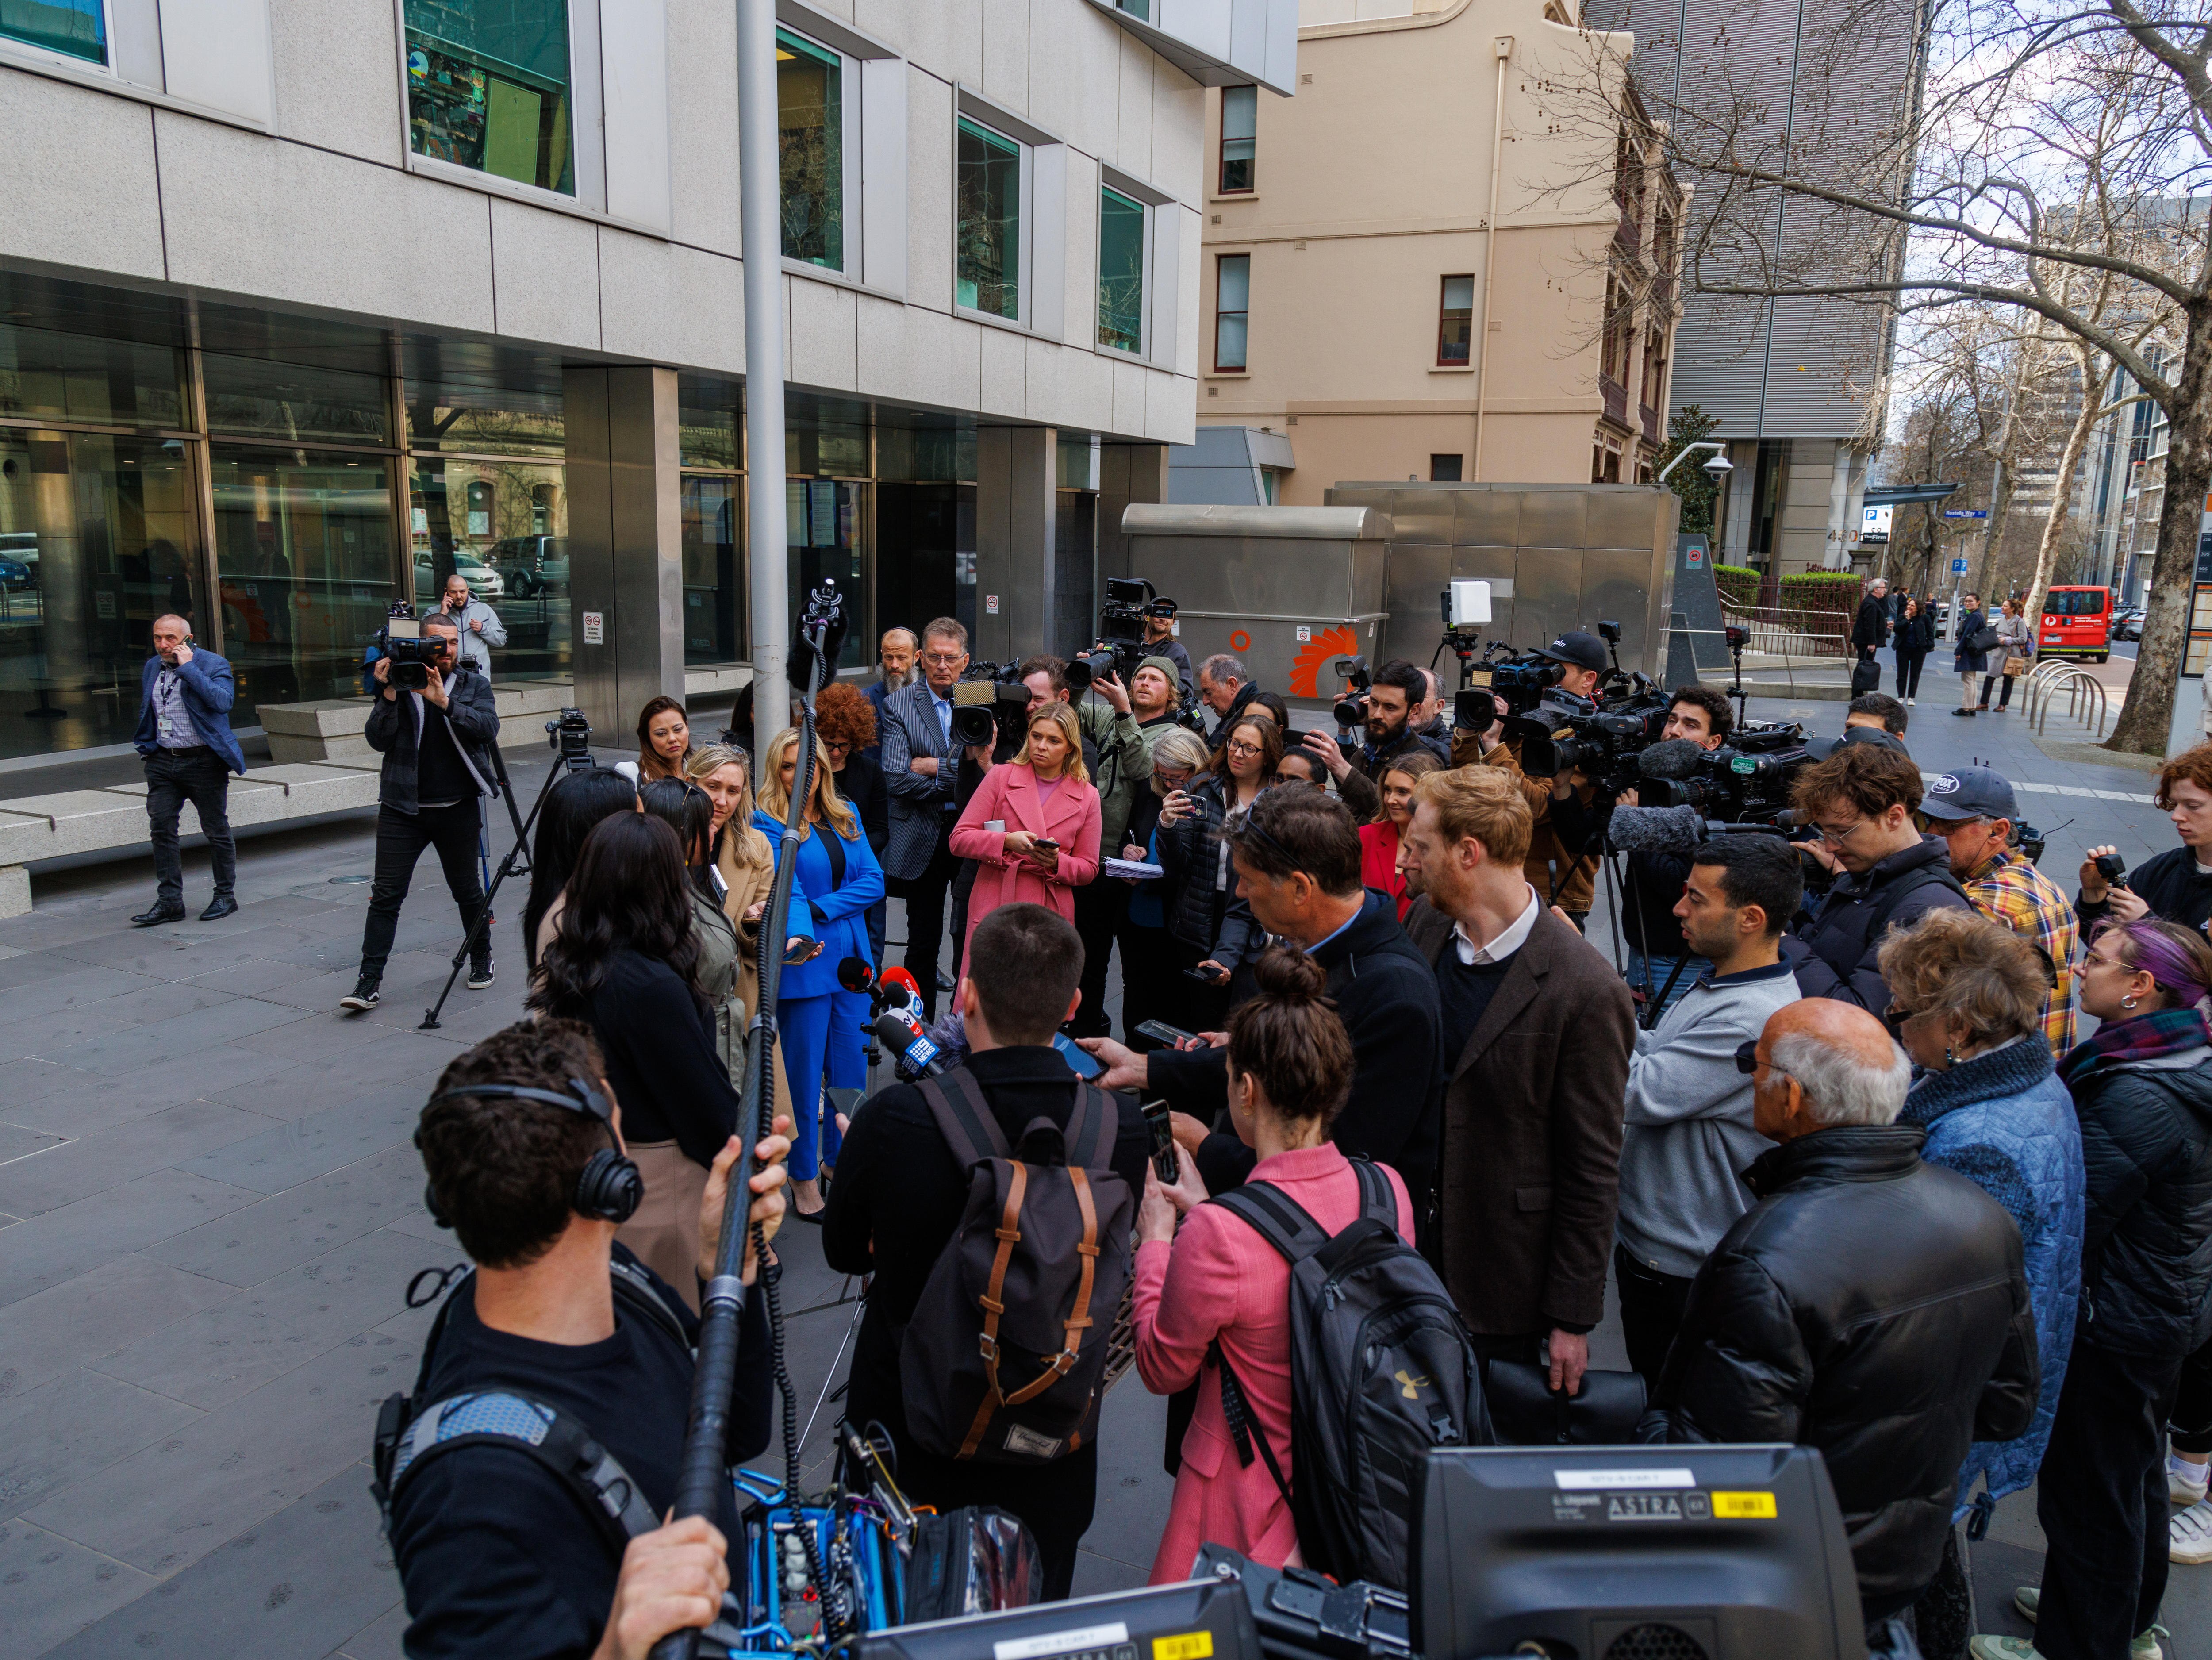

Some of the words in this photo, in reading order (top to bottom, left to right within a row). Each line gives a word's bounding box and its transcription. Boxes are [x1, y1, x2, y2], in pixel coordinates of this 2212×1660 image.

[1935, 777, 1955, 789] FOX
[918, 1045, 936, 1063] NEWS
[1609, 1495, 1682, 1516] ASTRA
